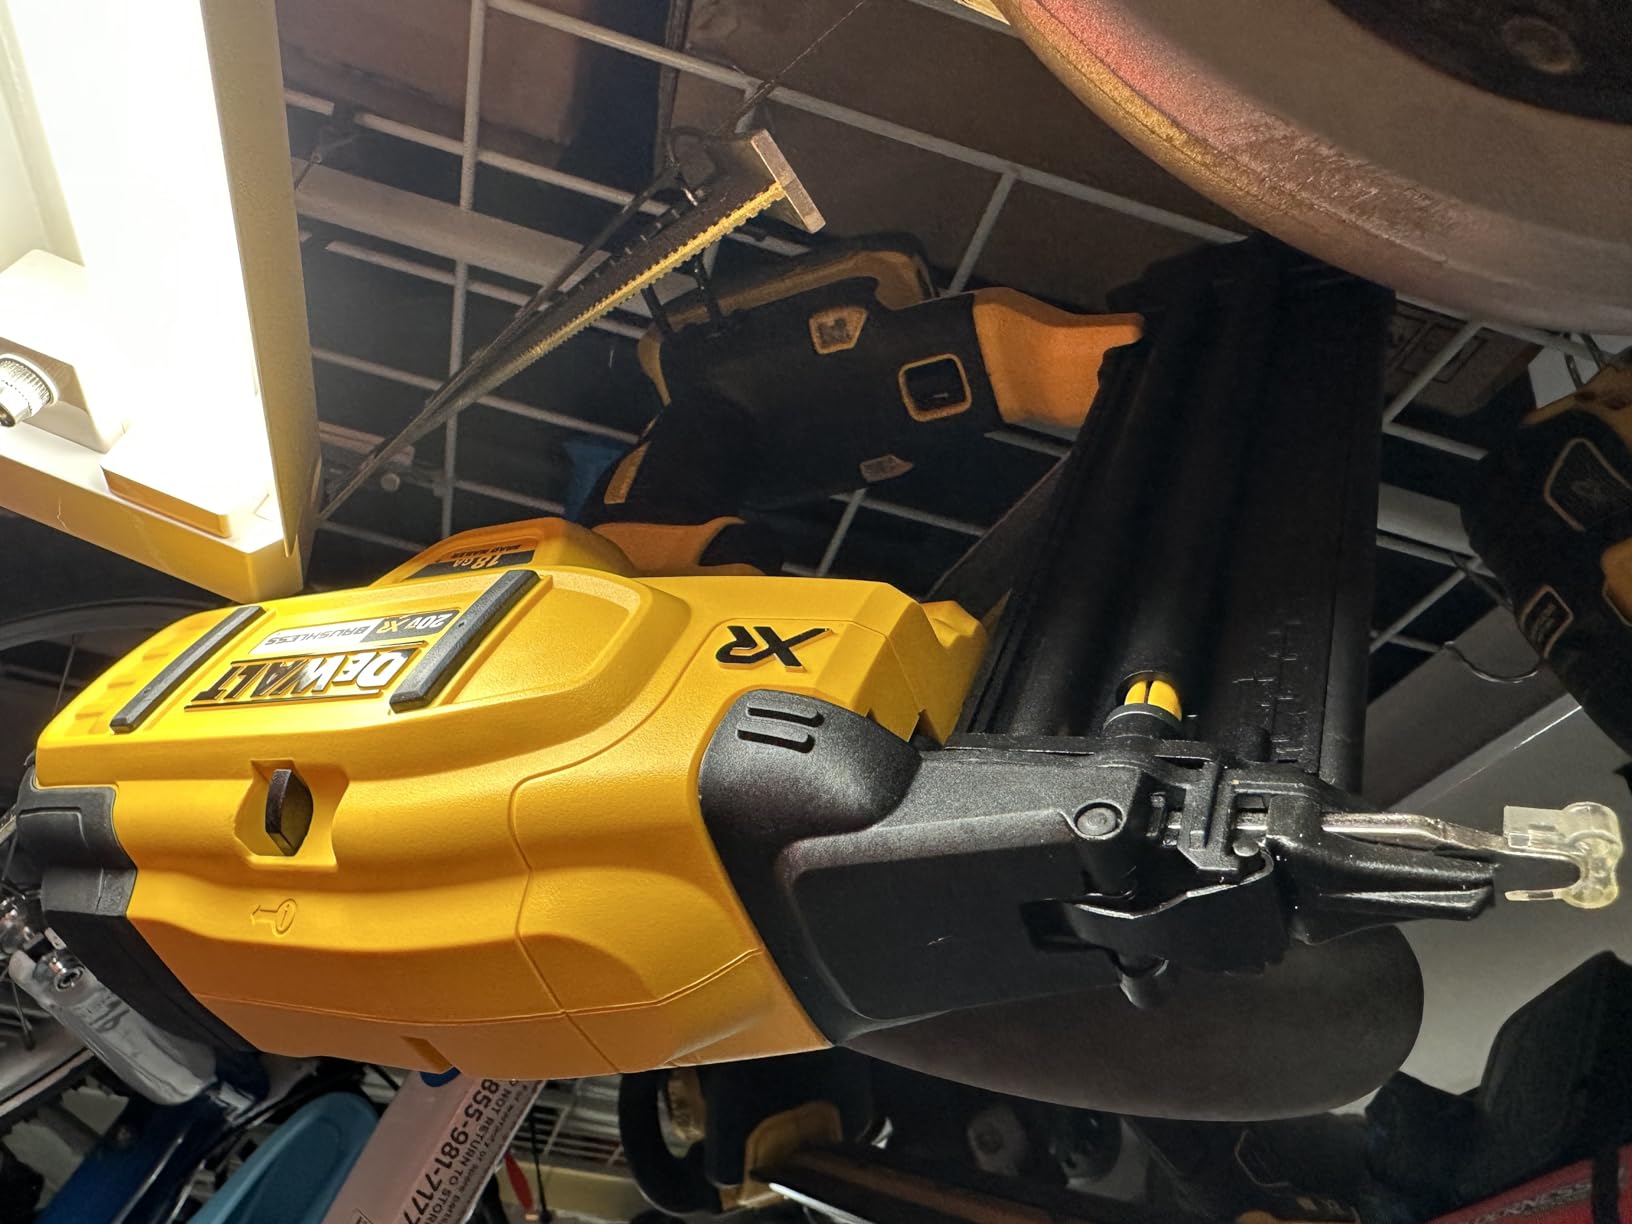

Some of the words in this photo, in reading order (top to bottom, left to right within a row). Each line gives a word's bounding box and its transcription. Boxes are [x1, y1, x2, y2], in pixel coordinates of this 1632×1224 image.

[453, 559, 471, 568] GA
[470, 554, 501, 569] 18
[264, 625, 371, 647] BRUSHLESS
[376, 614, 409, 635] XR
[715, 625, 831, 668] XR
[190, 649, 417, 702] DEWALT
[490, 1088, 513, 1115] NOT
[404, 1079, 500, 1224] 855-981-7177
[460, 1115, 495, 1167] RETURN
[449, 1169, 462, 1186] TO
